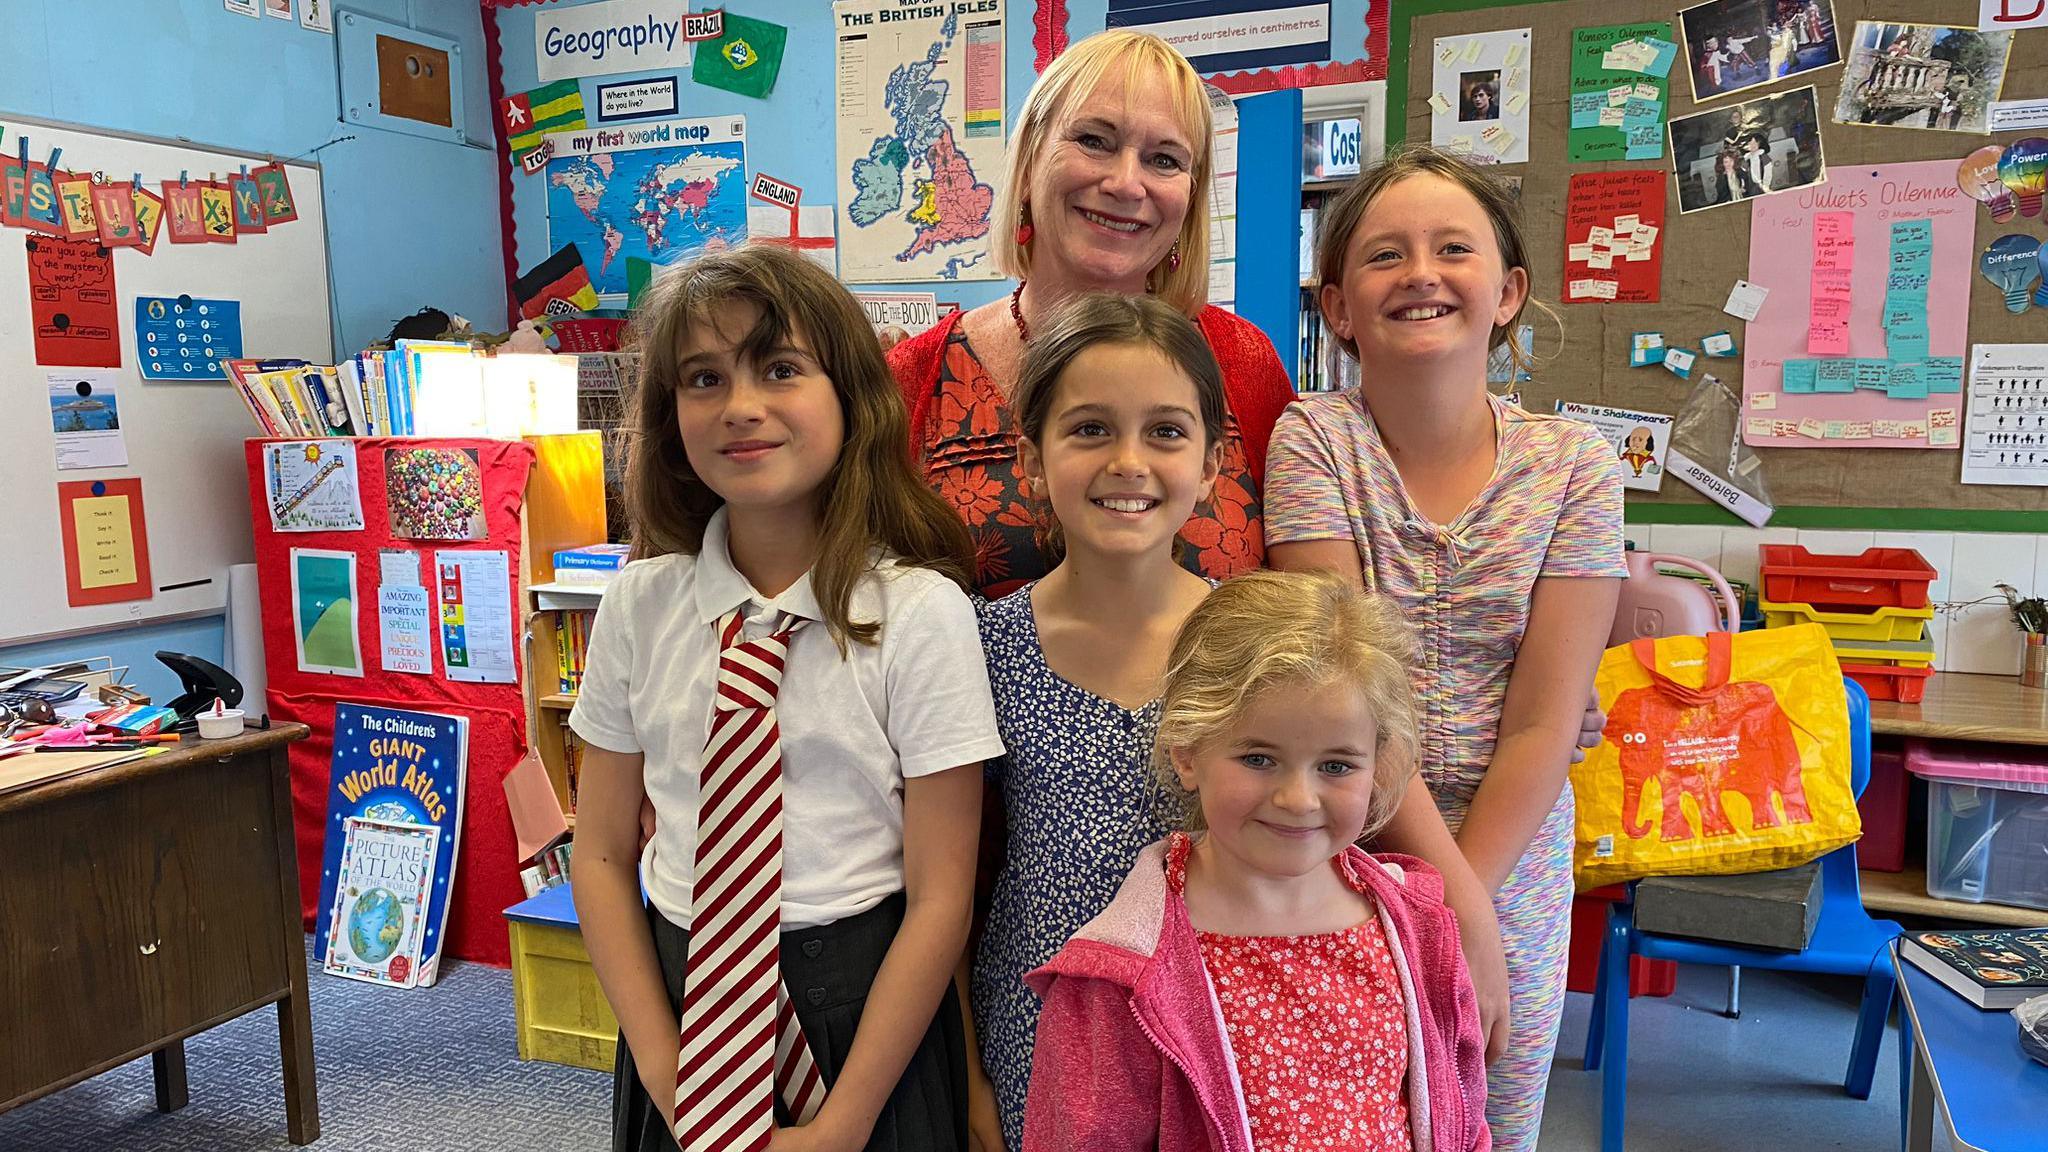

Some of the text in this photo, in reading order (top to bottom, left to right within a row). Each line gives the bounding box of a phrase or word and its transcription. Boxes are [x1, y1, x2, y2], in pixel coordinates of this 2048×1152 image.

[841, 0, 998, 27] THE BRITISH ISLES
[687, 14, 721, 36] BRAZIL
[1201, 26, 1246, 40] ourselves
[1249, 25, 1258, 35] in
[1260, 18, 1322, 35] centimetres.
[544, 14, 679, 60] Geography
[629, 89, 636, 97] in
[637, 88, 648, 96] the
[650, 85, 671, 95] World
[606, 99, 643, 111] do you live?
[572, 124, 709, 152] my first world map
[526, 142, 550, 167] TOG
[2011, 152, 2047, 166] Power
[1974, 163, 1998, 177] Lov
[30, 182, 51, 211] S
[237, 191, 251, 214] Y
[756, 179, 796, 205] ENGLAND
[1800, 181, 1958, 209] Juliet's Dilemma
[63, 193, 81, 219] T
[203, 198, 221, 222] X
[58, 246, 75, 260] you
[1987, 249, 2038, 265] Difference
[44, 260, 59, 270] the
[547, 299, 576, 318] GER
[861, 301, 889, 324] SIDE
[901, 302, 931, 325] BODY
[1567, 404, 1672, 425] Who is Shakespeare?
[1686, 466, 1740, 505] Balthasar
[564, 556, 590, 566] Primary
[384, 591, 422, 602] AMAZING
[381, 605, 427, 617] IMPORTANT
[388, 620, 420, 630] SPECIAL
[388, 647, 425, 657] PRECIOUS
[393, 661, 421, 671] LOVED
[361, 714, 436, 738] The Children's
[369, 738, 426, 763] GIANT
[338, 758, 447, 822] World Atlas
[356, 839, 421, 862] PICTURE
[352, 856, 419, 883] ATLAS
[386, 881, 416, 892] WORLD
